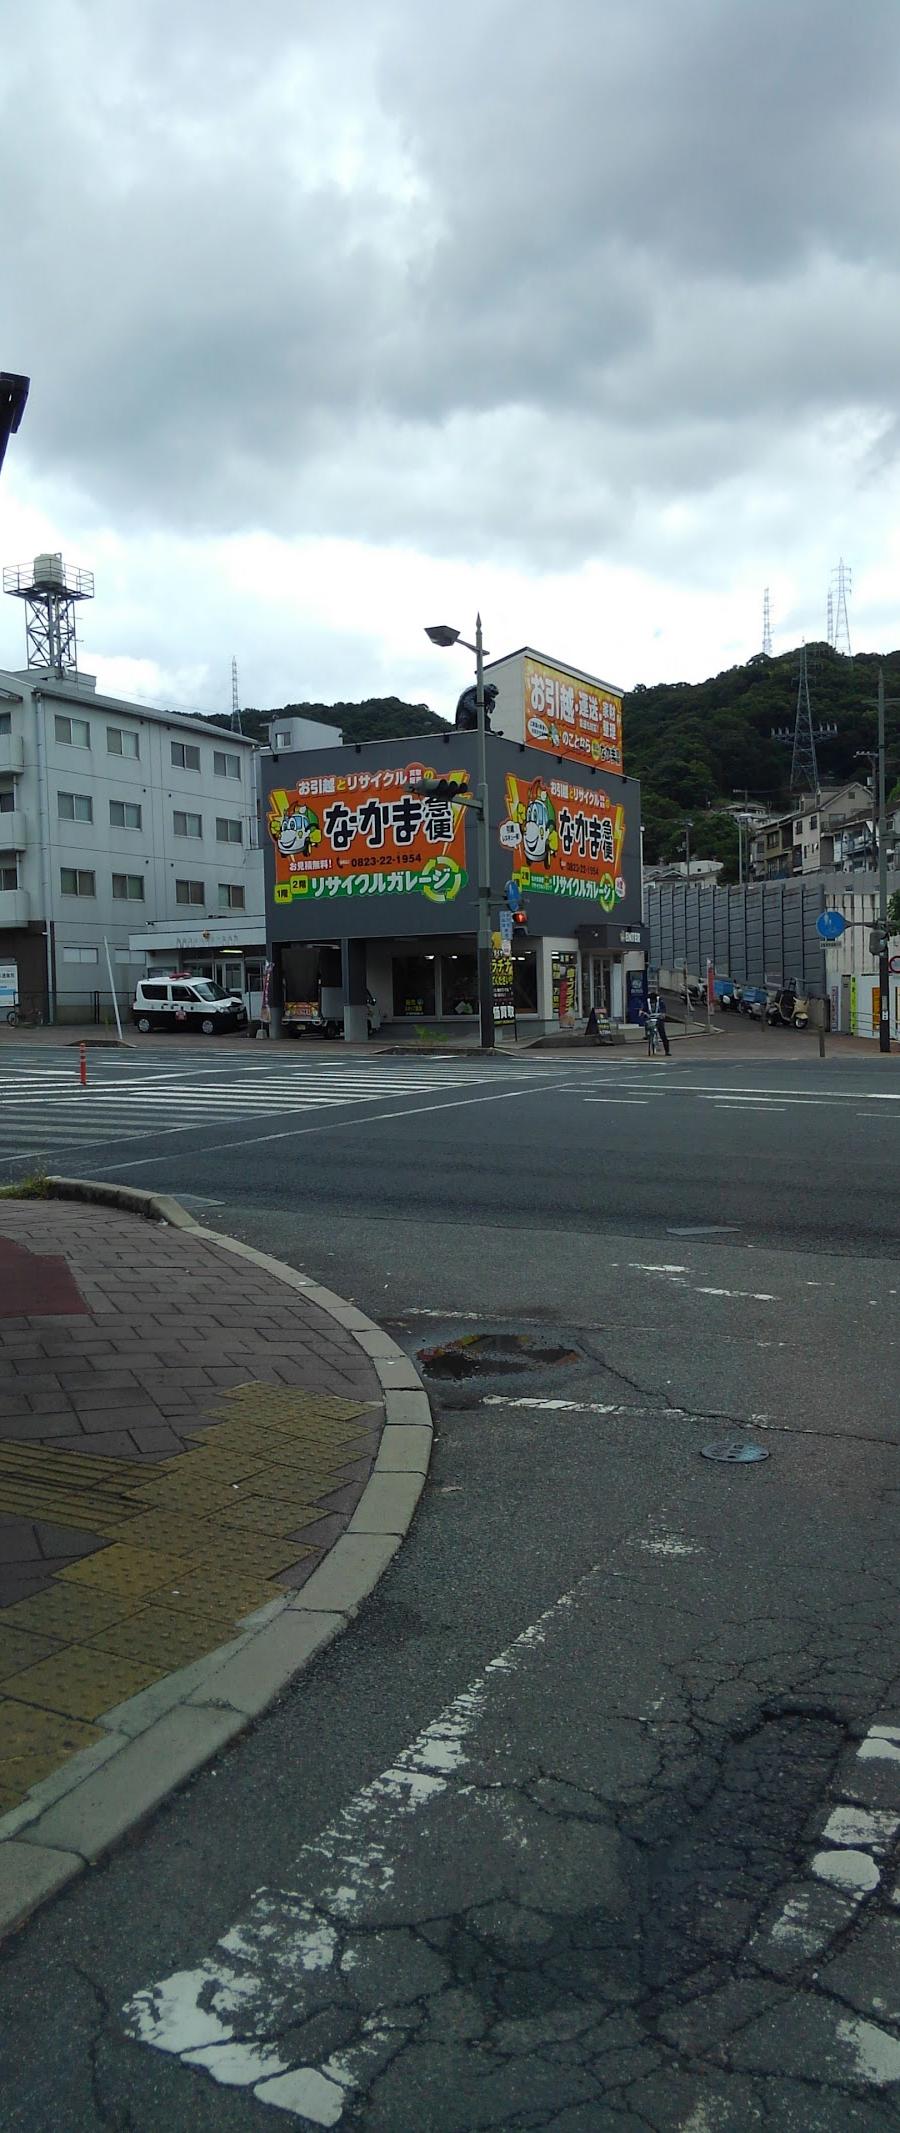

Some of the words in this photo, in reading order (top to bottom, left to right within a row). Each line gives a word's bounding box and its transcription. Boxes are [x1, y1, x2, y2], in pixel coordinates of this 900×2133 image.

[311, 868, 450, 896] リサイクルガレージ
[553, 875, 611, 900] リサイクルガレージ
